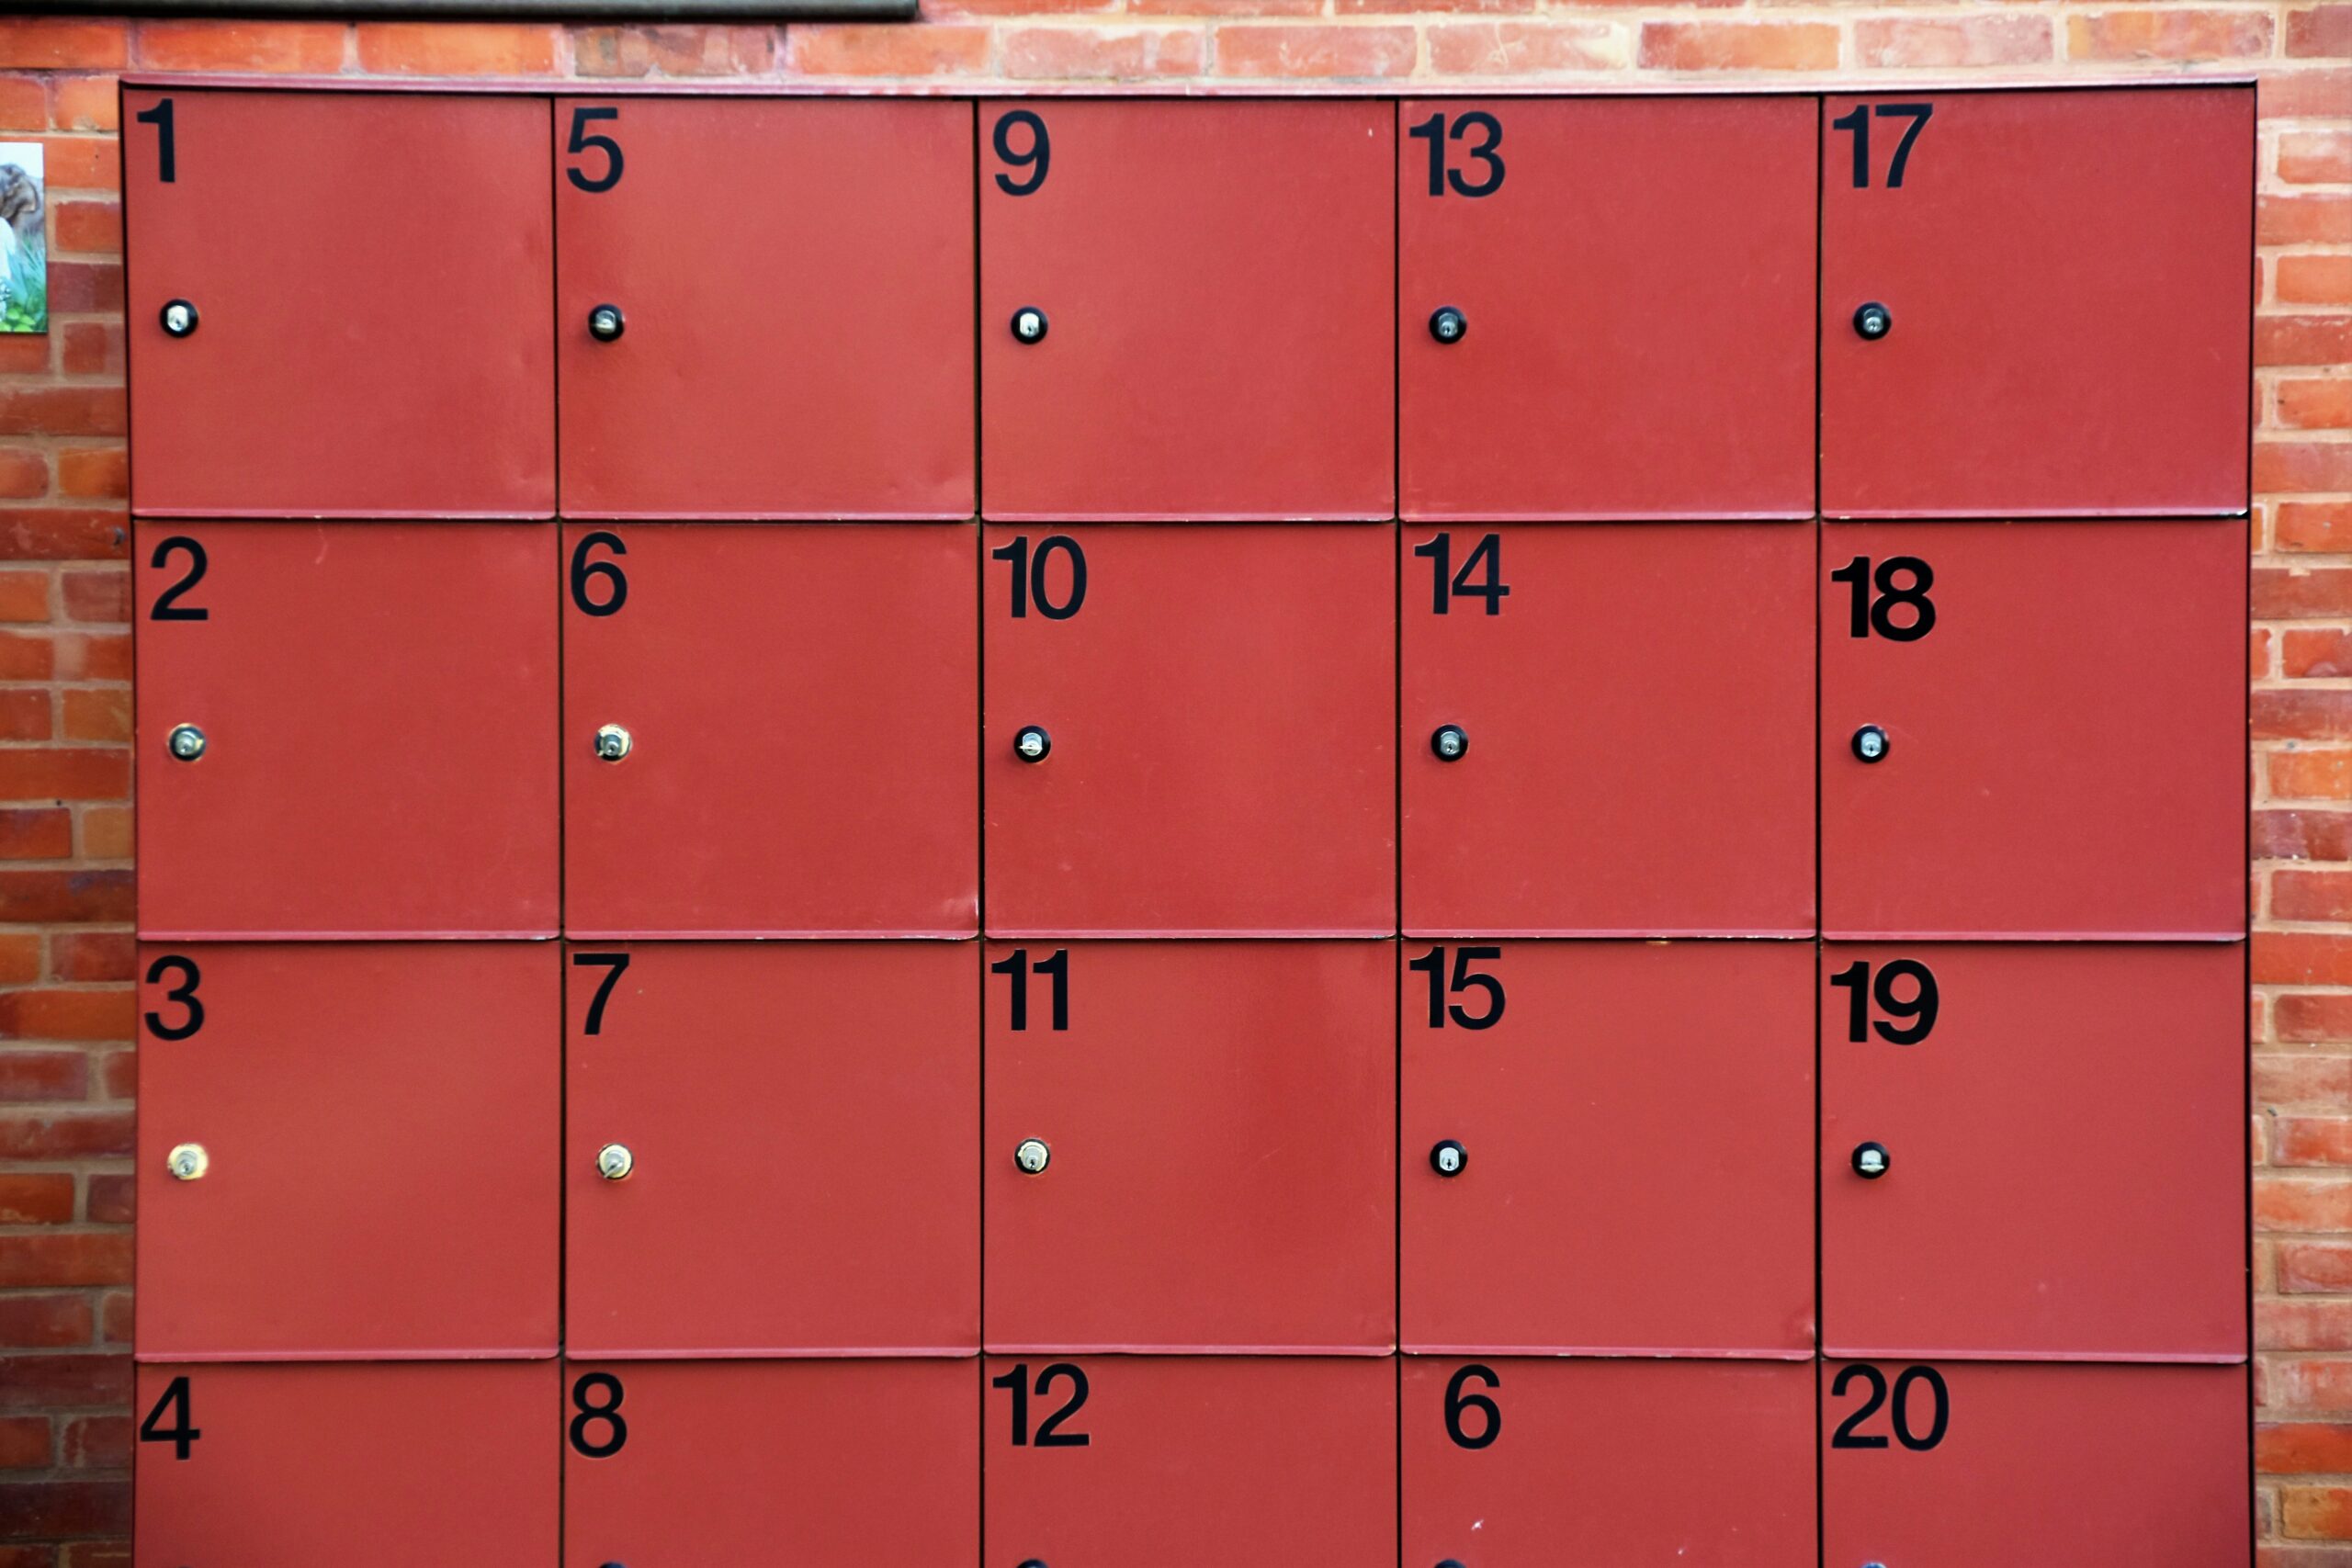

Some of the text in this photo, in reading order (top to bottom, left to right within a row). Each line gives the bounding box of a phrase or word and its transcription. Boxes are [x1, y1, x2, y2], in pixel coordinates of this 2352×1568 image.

[137, 97, 175, 183] 1
[567, 107, 624, 193] 5
[993, 110, 1050, 197] 9
[1409, 111, 1506, 197] 13
[1833, 103, 1933, 188] 17
[151, 536, 209, 621] 2
[571, 531, 628, 617] 6
[992, 536, 1087, 620] 10
[1414, 532, 1510, 615] 14
[1831, 556, 1937, 642] 18
[144, 954, 205, 1042] 3
[572, 953, 630, 1035] 7
[991, 949, 1069, 1032] 11
[1409, 945, 1506, 1031] 15
[1830, 959, 1939, 1045] 19
[140, 1375, 201, 1461] 4
[569, 1371, 628, 1459] 8
[992, 1362, 1090, 1448] 12
[1444, 1363, 1501, 1450] 6
[1830, 1363, 1951, 1451] 20
